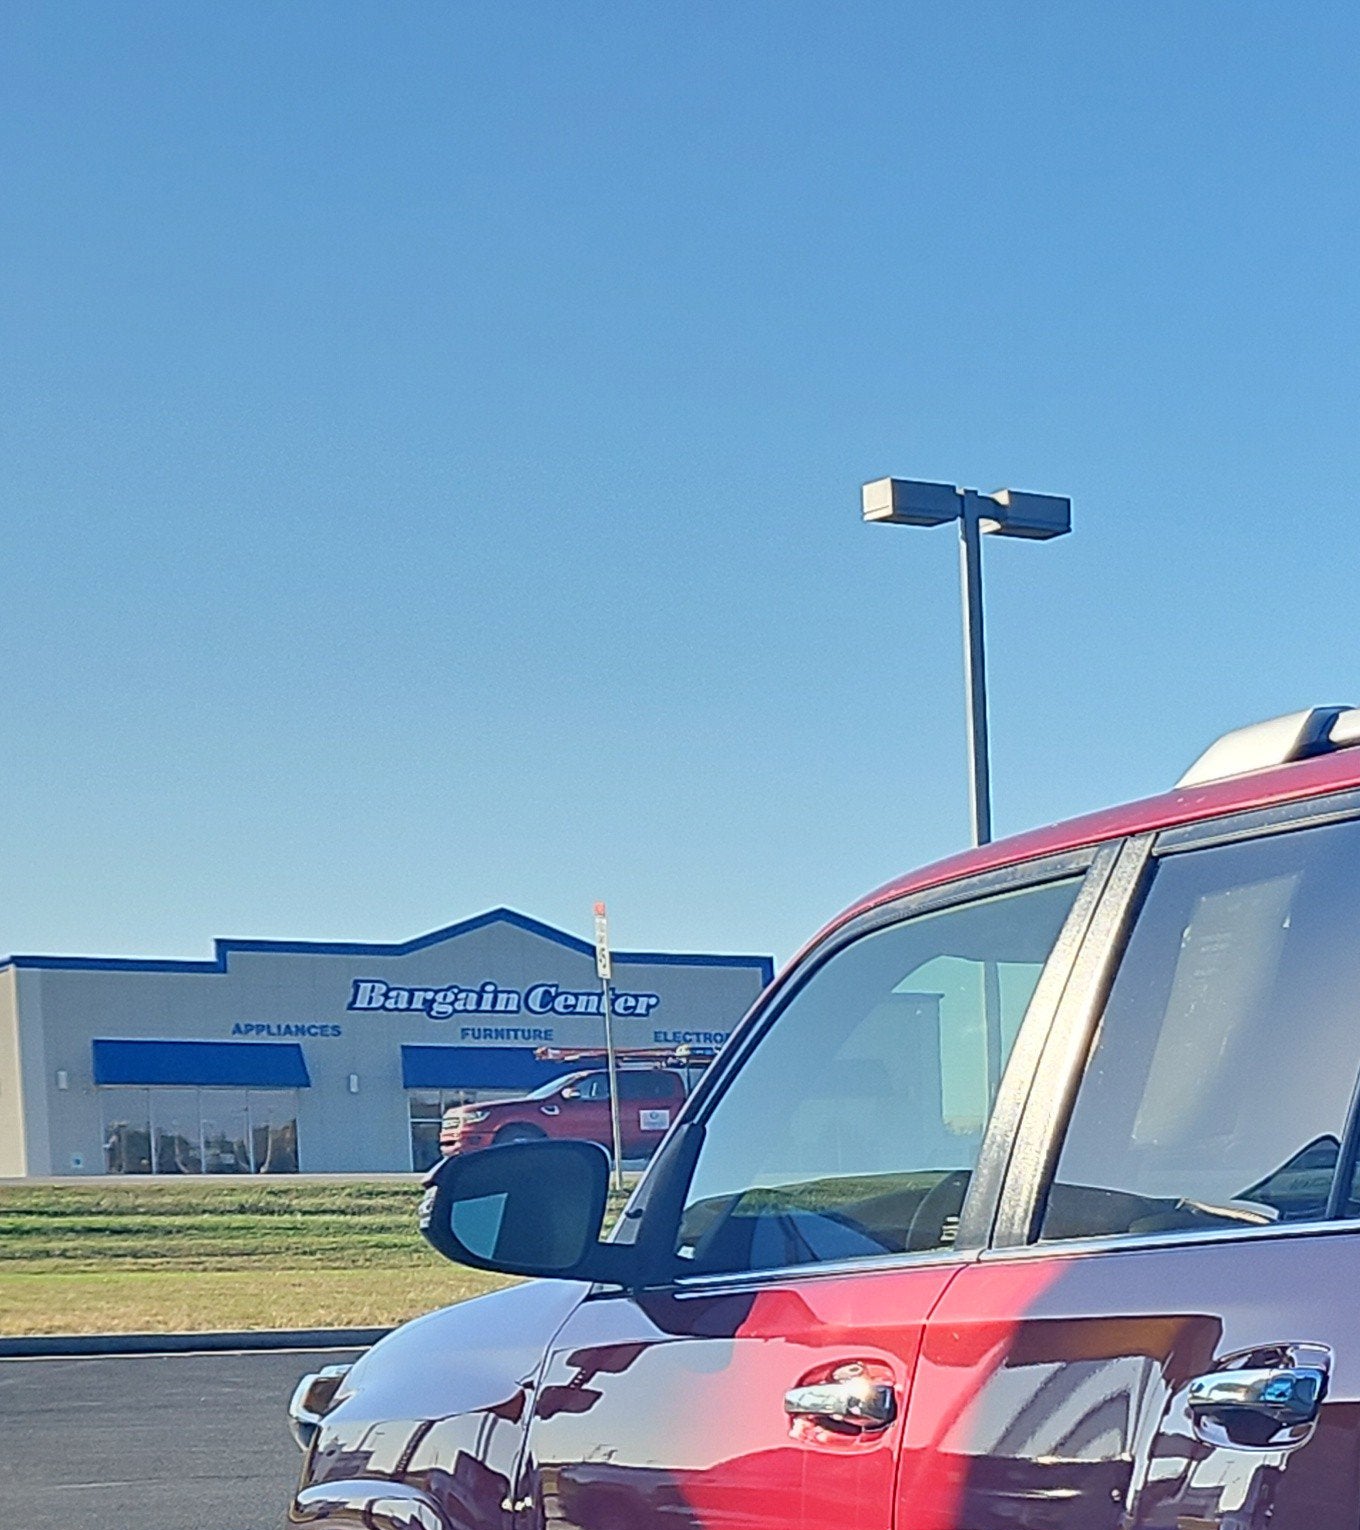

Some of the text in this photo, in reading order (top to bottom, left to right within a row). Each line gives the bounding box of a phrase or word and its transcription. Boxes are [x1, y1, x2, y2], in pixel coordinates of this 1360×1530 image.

[349, 979, 520, 1019] Bargain
[232, 1022, 342, 1037] APPLIANCES
[460, 1027, 553, 1042] FURNITURE
